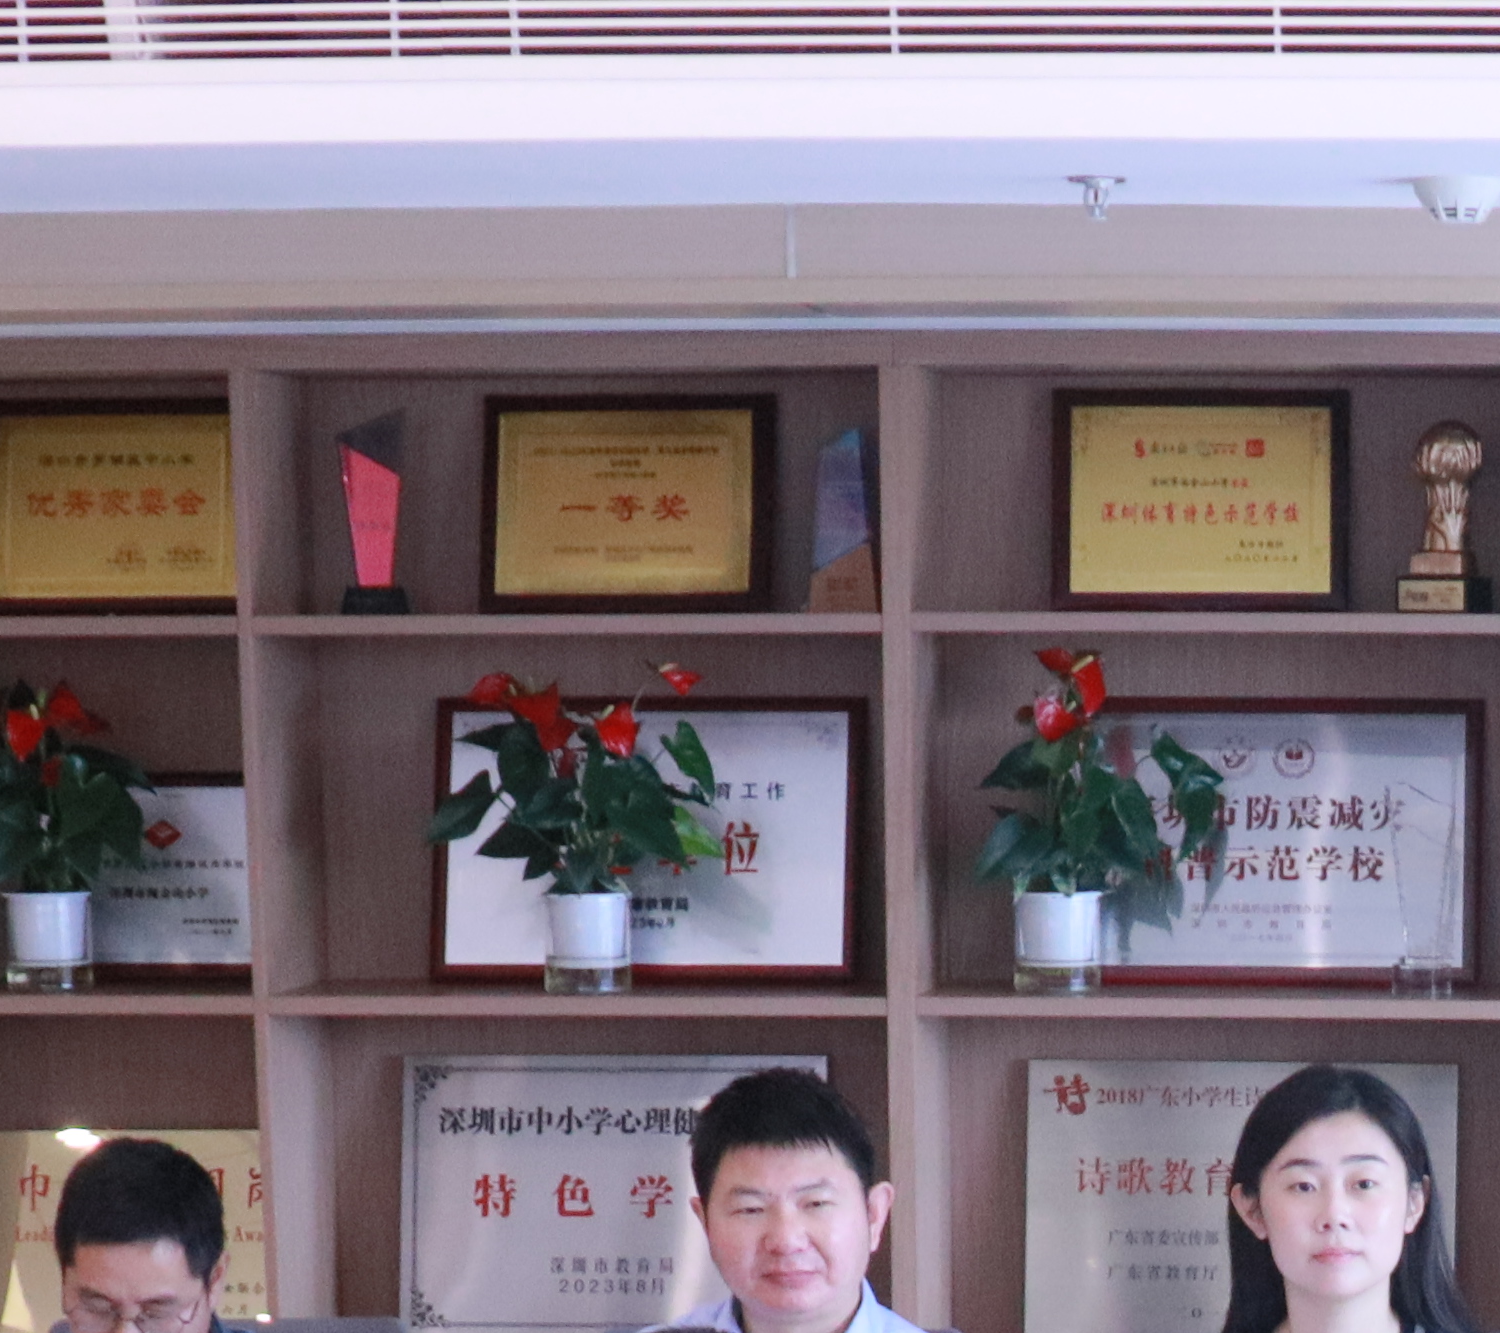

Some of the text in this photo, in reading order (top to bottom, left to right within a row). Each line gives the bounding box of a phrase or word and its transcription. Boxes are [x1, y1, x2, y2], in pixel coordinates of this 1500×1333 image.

[559, 494, 692, 523] 一等奖
[473, 1174, 674, 1219] 特色学
[550, 1256, 674, 1275] 深圳市教育局
[559, 1278, 666, 1296] 2023年8月
